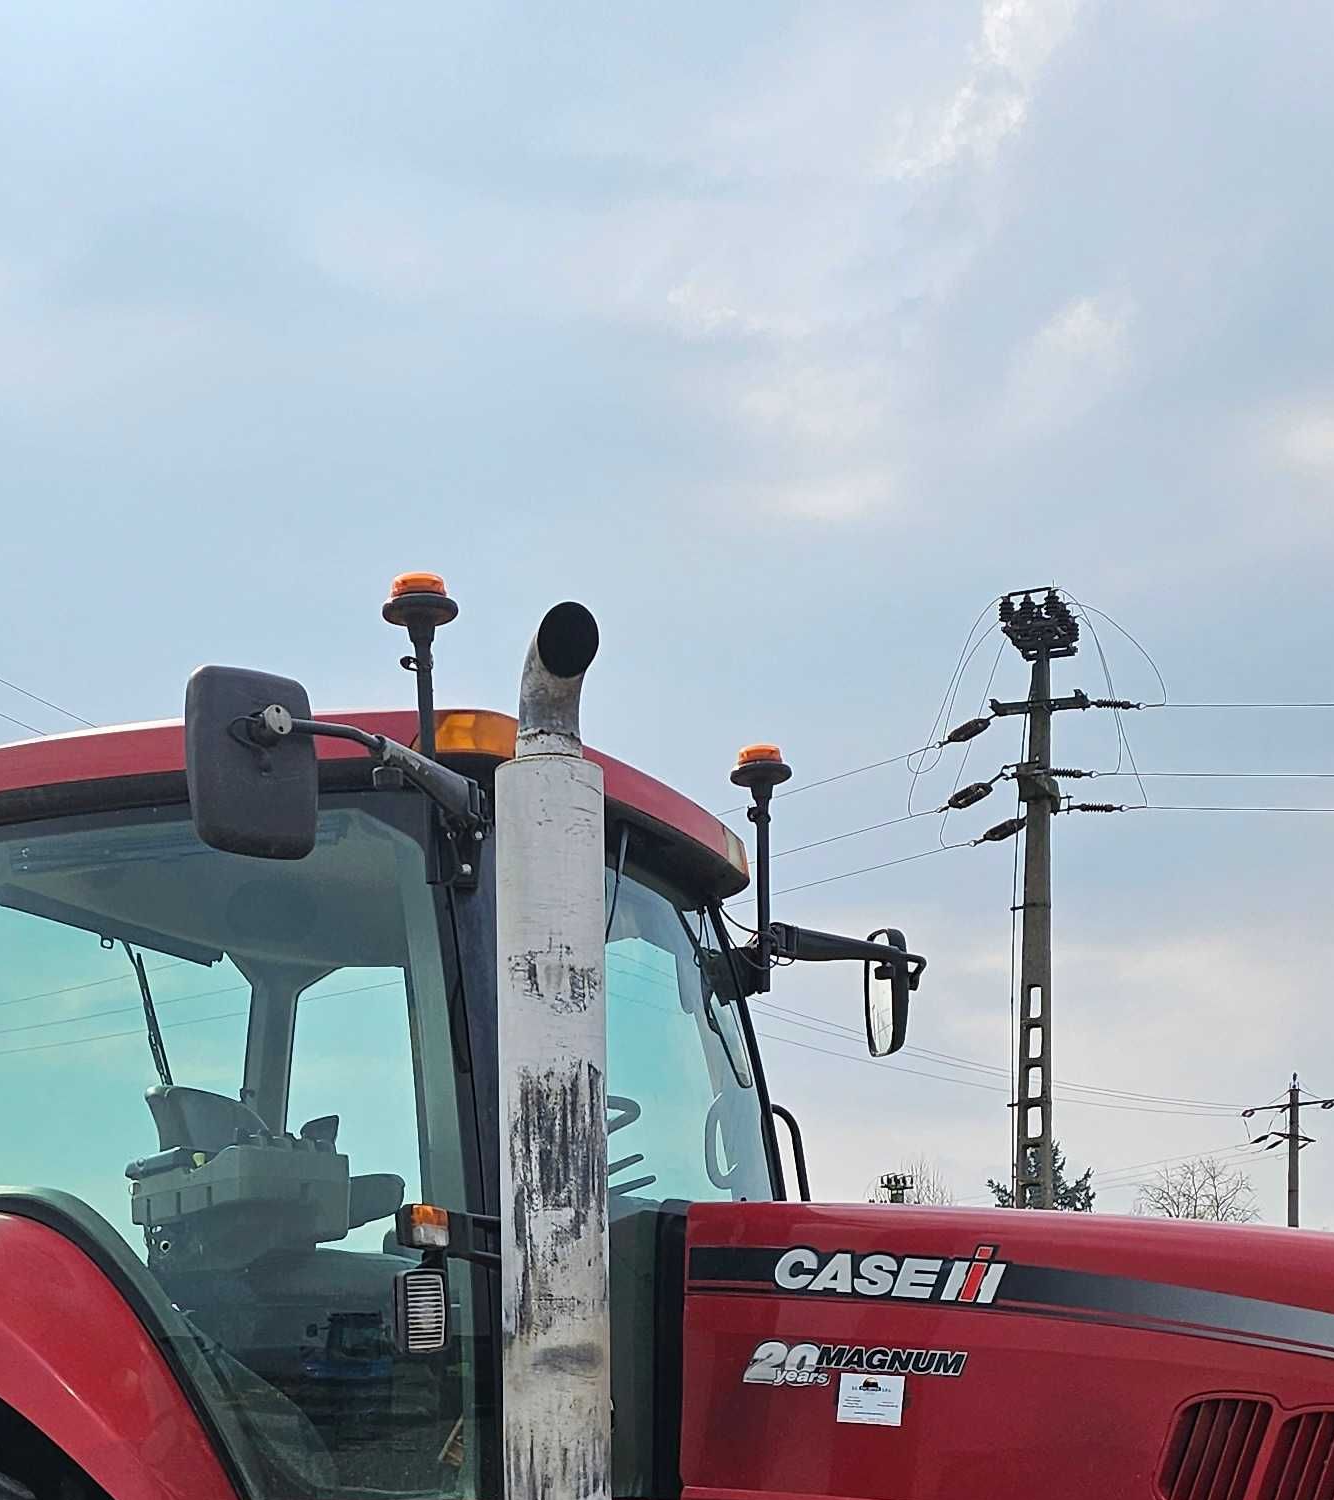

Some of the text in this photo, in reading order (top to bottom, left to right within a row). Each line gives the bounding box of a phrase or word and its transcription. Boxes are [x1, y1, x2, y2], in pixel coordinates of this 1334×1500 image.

[774, 1248, 944, 1299] CASE
[743, 1340, 968, 1385] 20 MAGNUM
[773, 1369, 831, 1387] years
